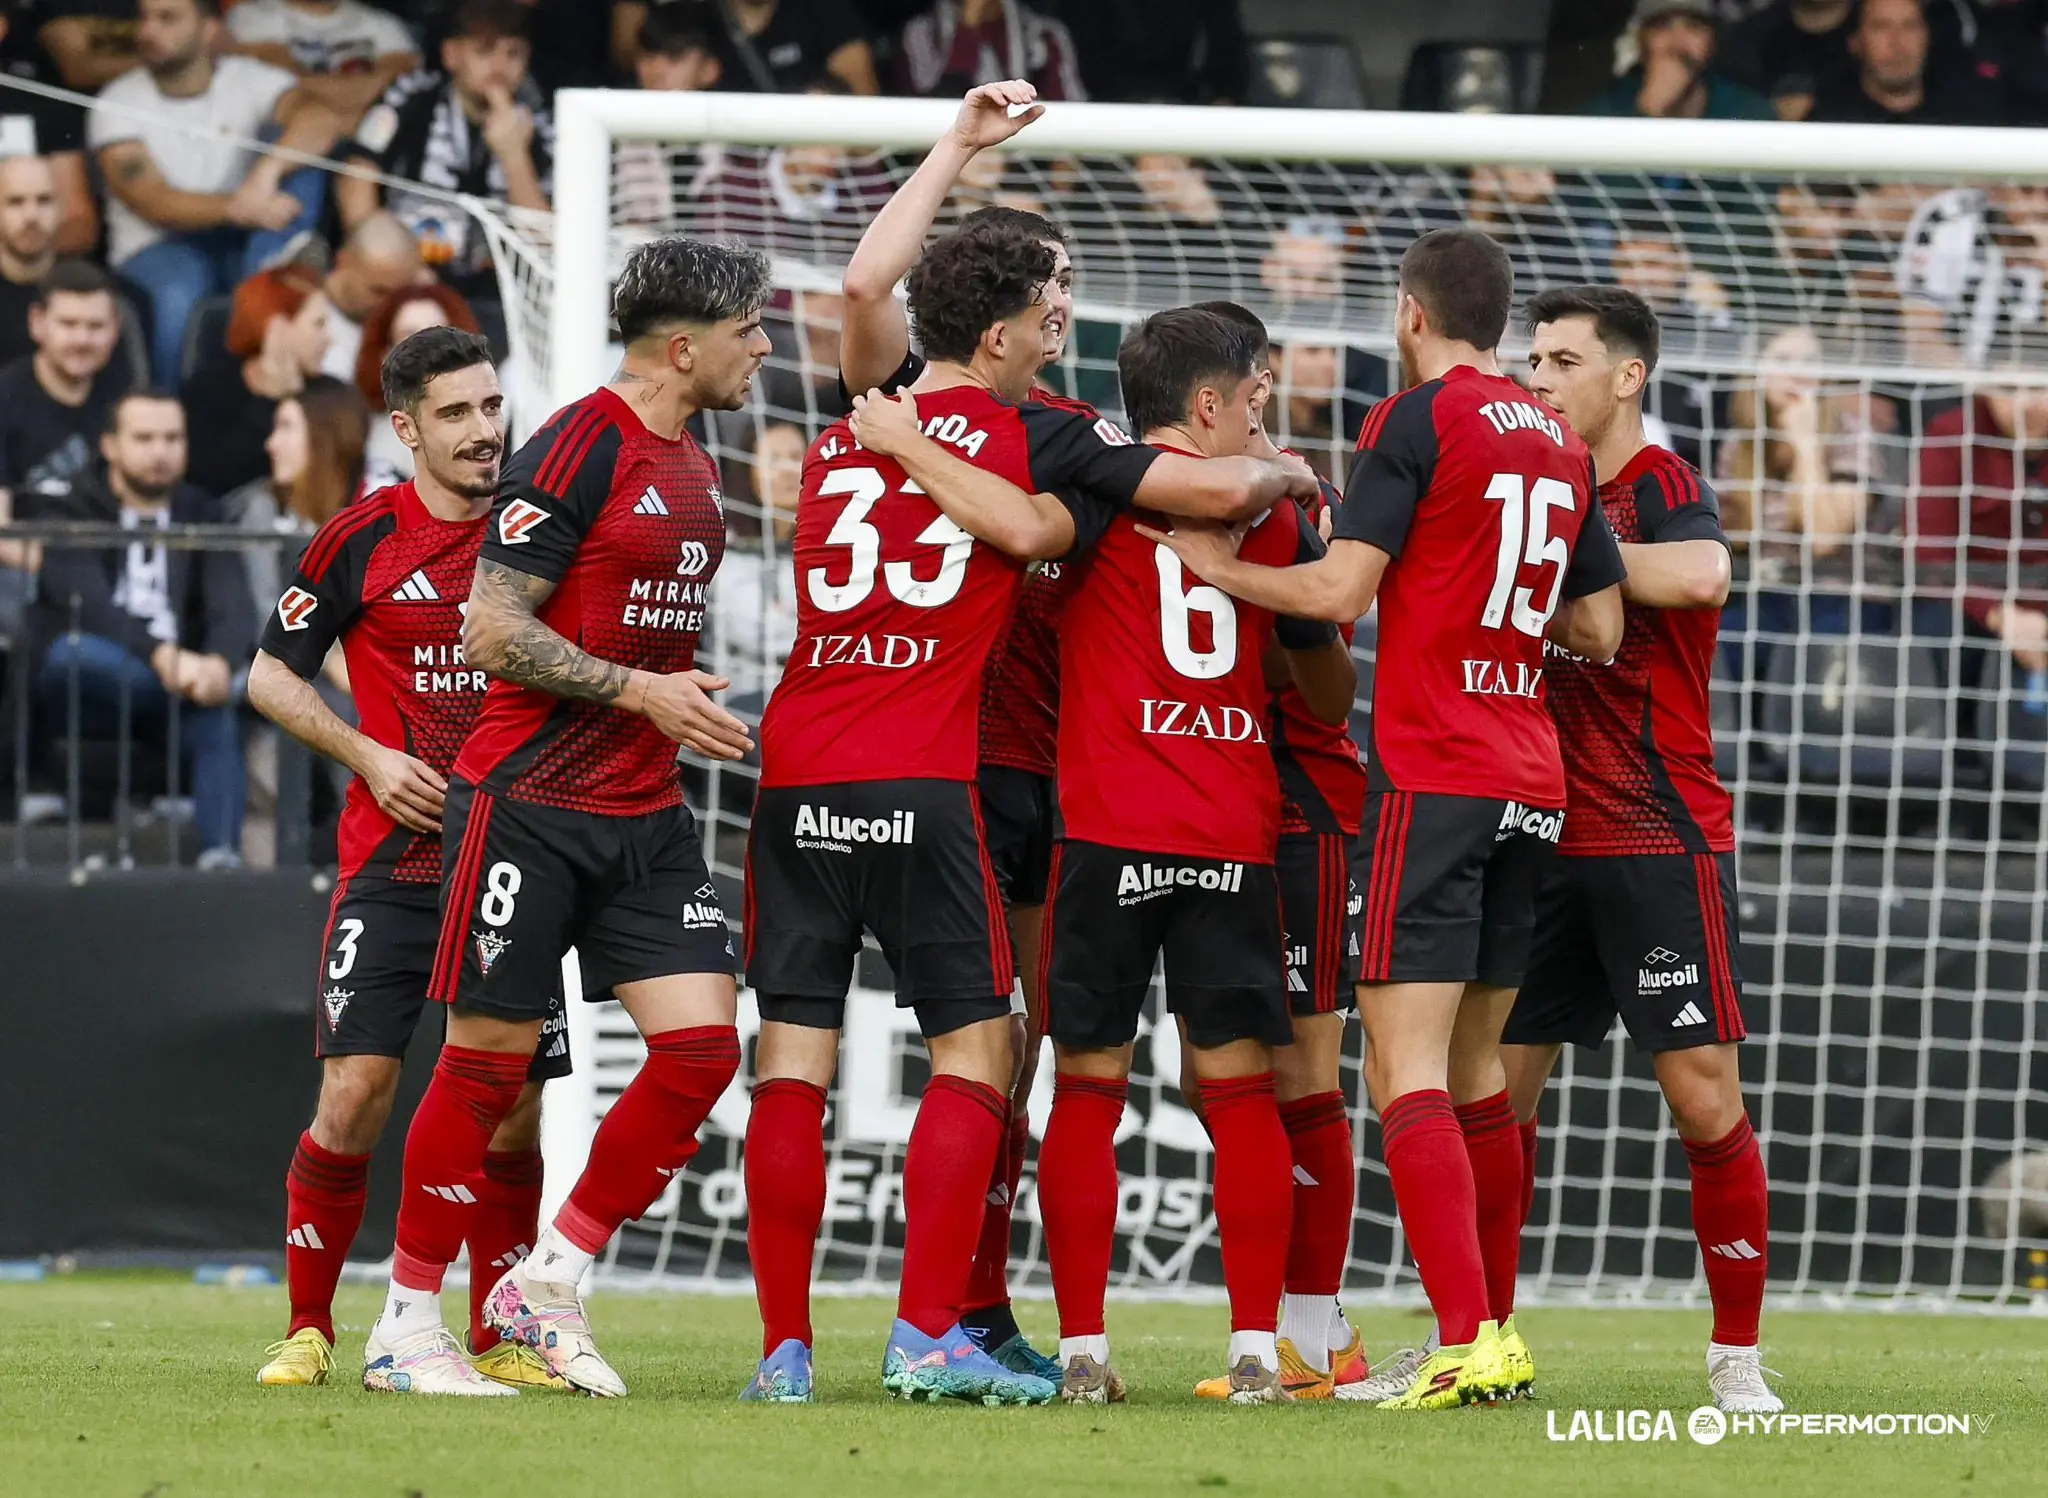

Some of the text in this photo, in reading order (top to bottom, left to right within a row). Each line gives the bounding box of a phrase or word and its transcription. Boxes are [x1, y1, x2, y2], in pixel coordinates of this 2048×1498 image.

[1478, 400, 1565, 448] TOMEO
[807, 466, 976, 613] 33
[1480, 473, 1576, 638] 15
[1154, 530, 1238, 680] 6
[807, 633, 941, 669] IZADI
[794, 804, 915, 844] Alucoil
[796, 838, 820, 849] Grupo
[480, 861, 522, 927] 8
[1117, 862, 1244, 896] Alucoil
[1118, 895, 1142, 907] Grupo
[328, 918, 365, 980] 3
[1638, 964, 1699, 988] Alucoil
